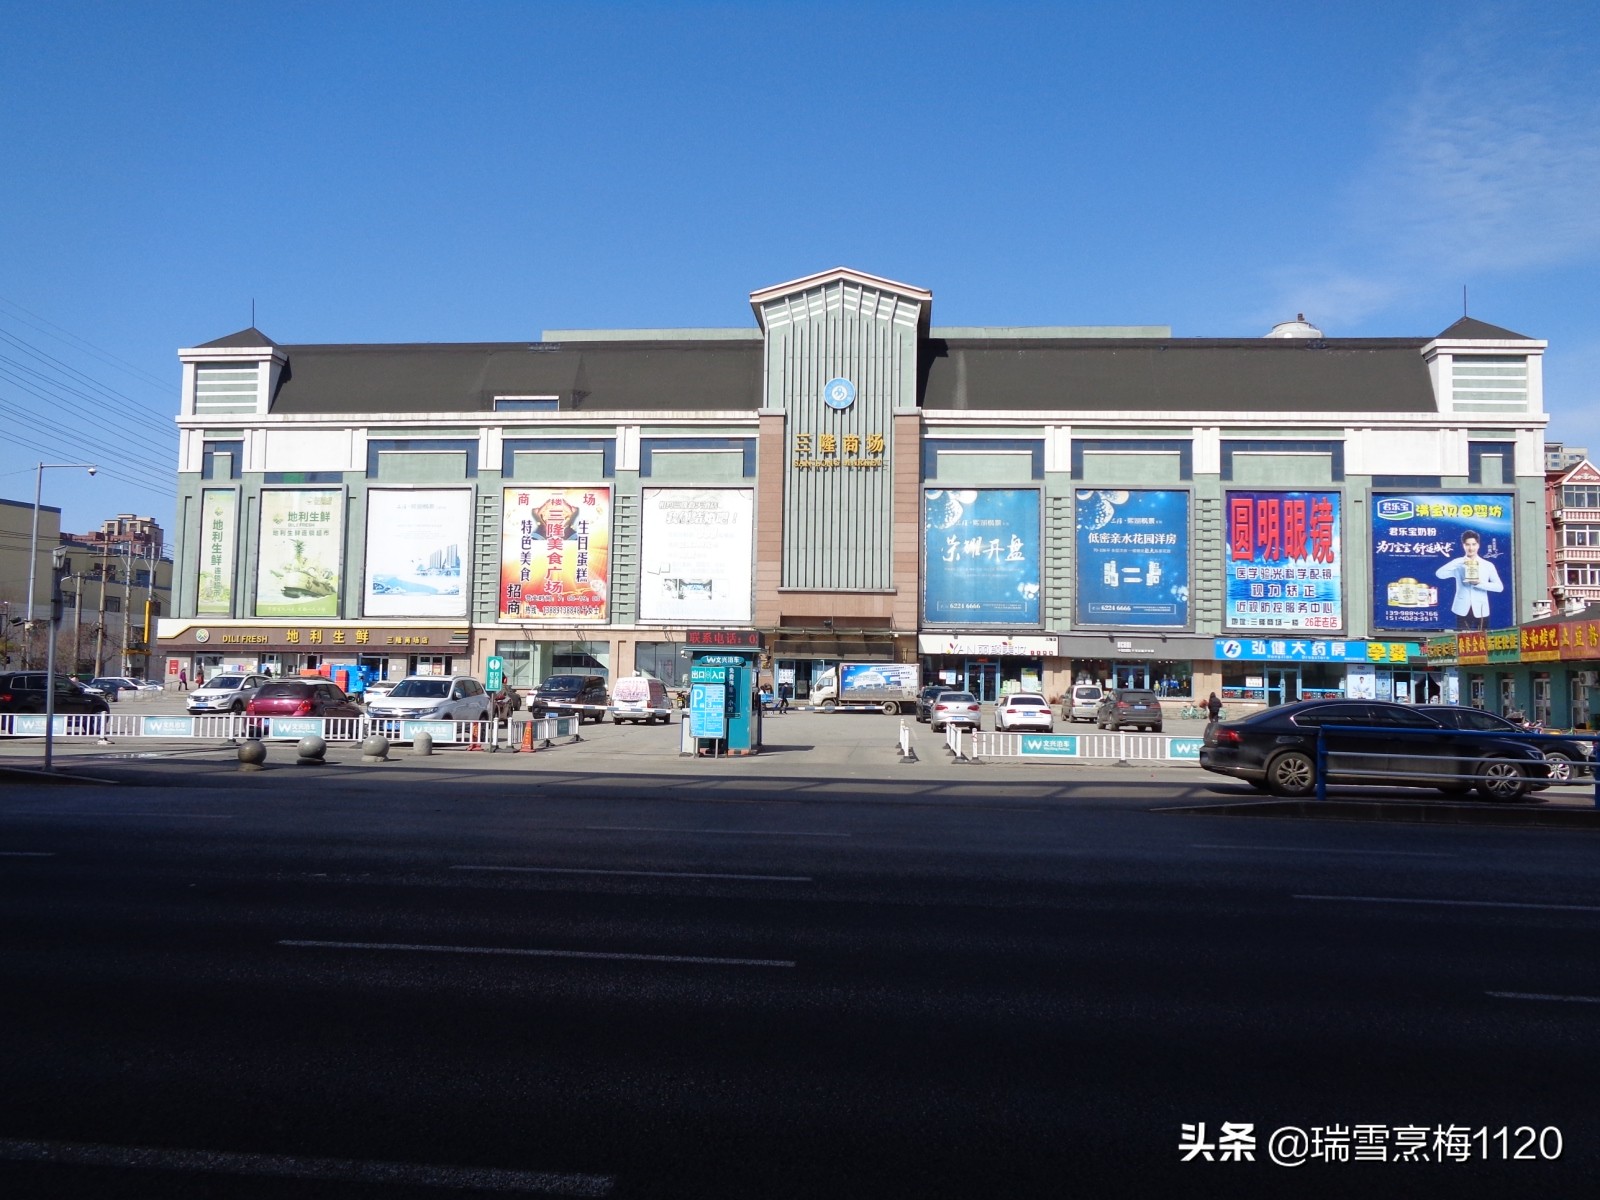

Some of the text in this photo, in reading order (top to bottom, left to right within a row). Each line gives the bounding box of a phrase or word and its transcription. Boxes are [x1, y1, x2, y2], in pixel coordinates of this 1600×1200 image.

[795, 433, 884, 454] 三隆商场
[518, 493, 596, 506] 商 场
[1382, 502, 1410, 511] 君乐宝
[287, 511, 331, 522] 地利生鲜
[1231, 497, 1335, 564] 圆明眼镜
[1389, 527, 1437, 537] 君乐宝奶粉
[211, 520, 224, 566] 地利生鲜
[1088, 532, 1177, 545] 低密亲水花园洋房
[521, 520, 533, 582] 特色美食
[544, 510, 565, 594] 三隆美食广场
[576, 520, 589, 583] 生日蛋糕
[1236, 568, 1332, 580] 医学验光科学配镜
[1252, 584, 1316, 597] 视力矫正
[507, 584, 521, 615] 招商
[1236, 601, 1333, 613] 近视防控服务中心
[1304, 616, 1338, 628] 26年老店
[222, 635, 269, 644] DILI FRESH
[286, 629, 369, 645] 地利生鲜
[1252, 640, 1346, 657] 弘健大药房
[1368, 643, 1407, 662] 孕婴
[691, 670, 725, 679] 出口 入口
[693, 689, 704, 708] P
